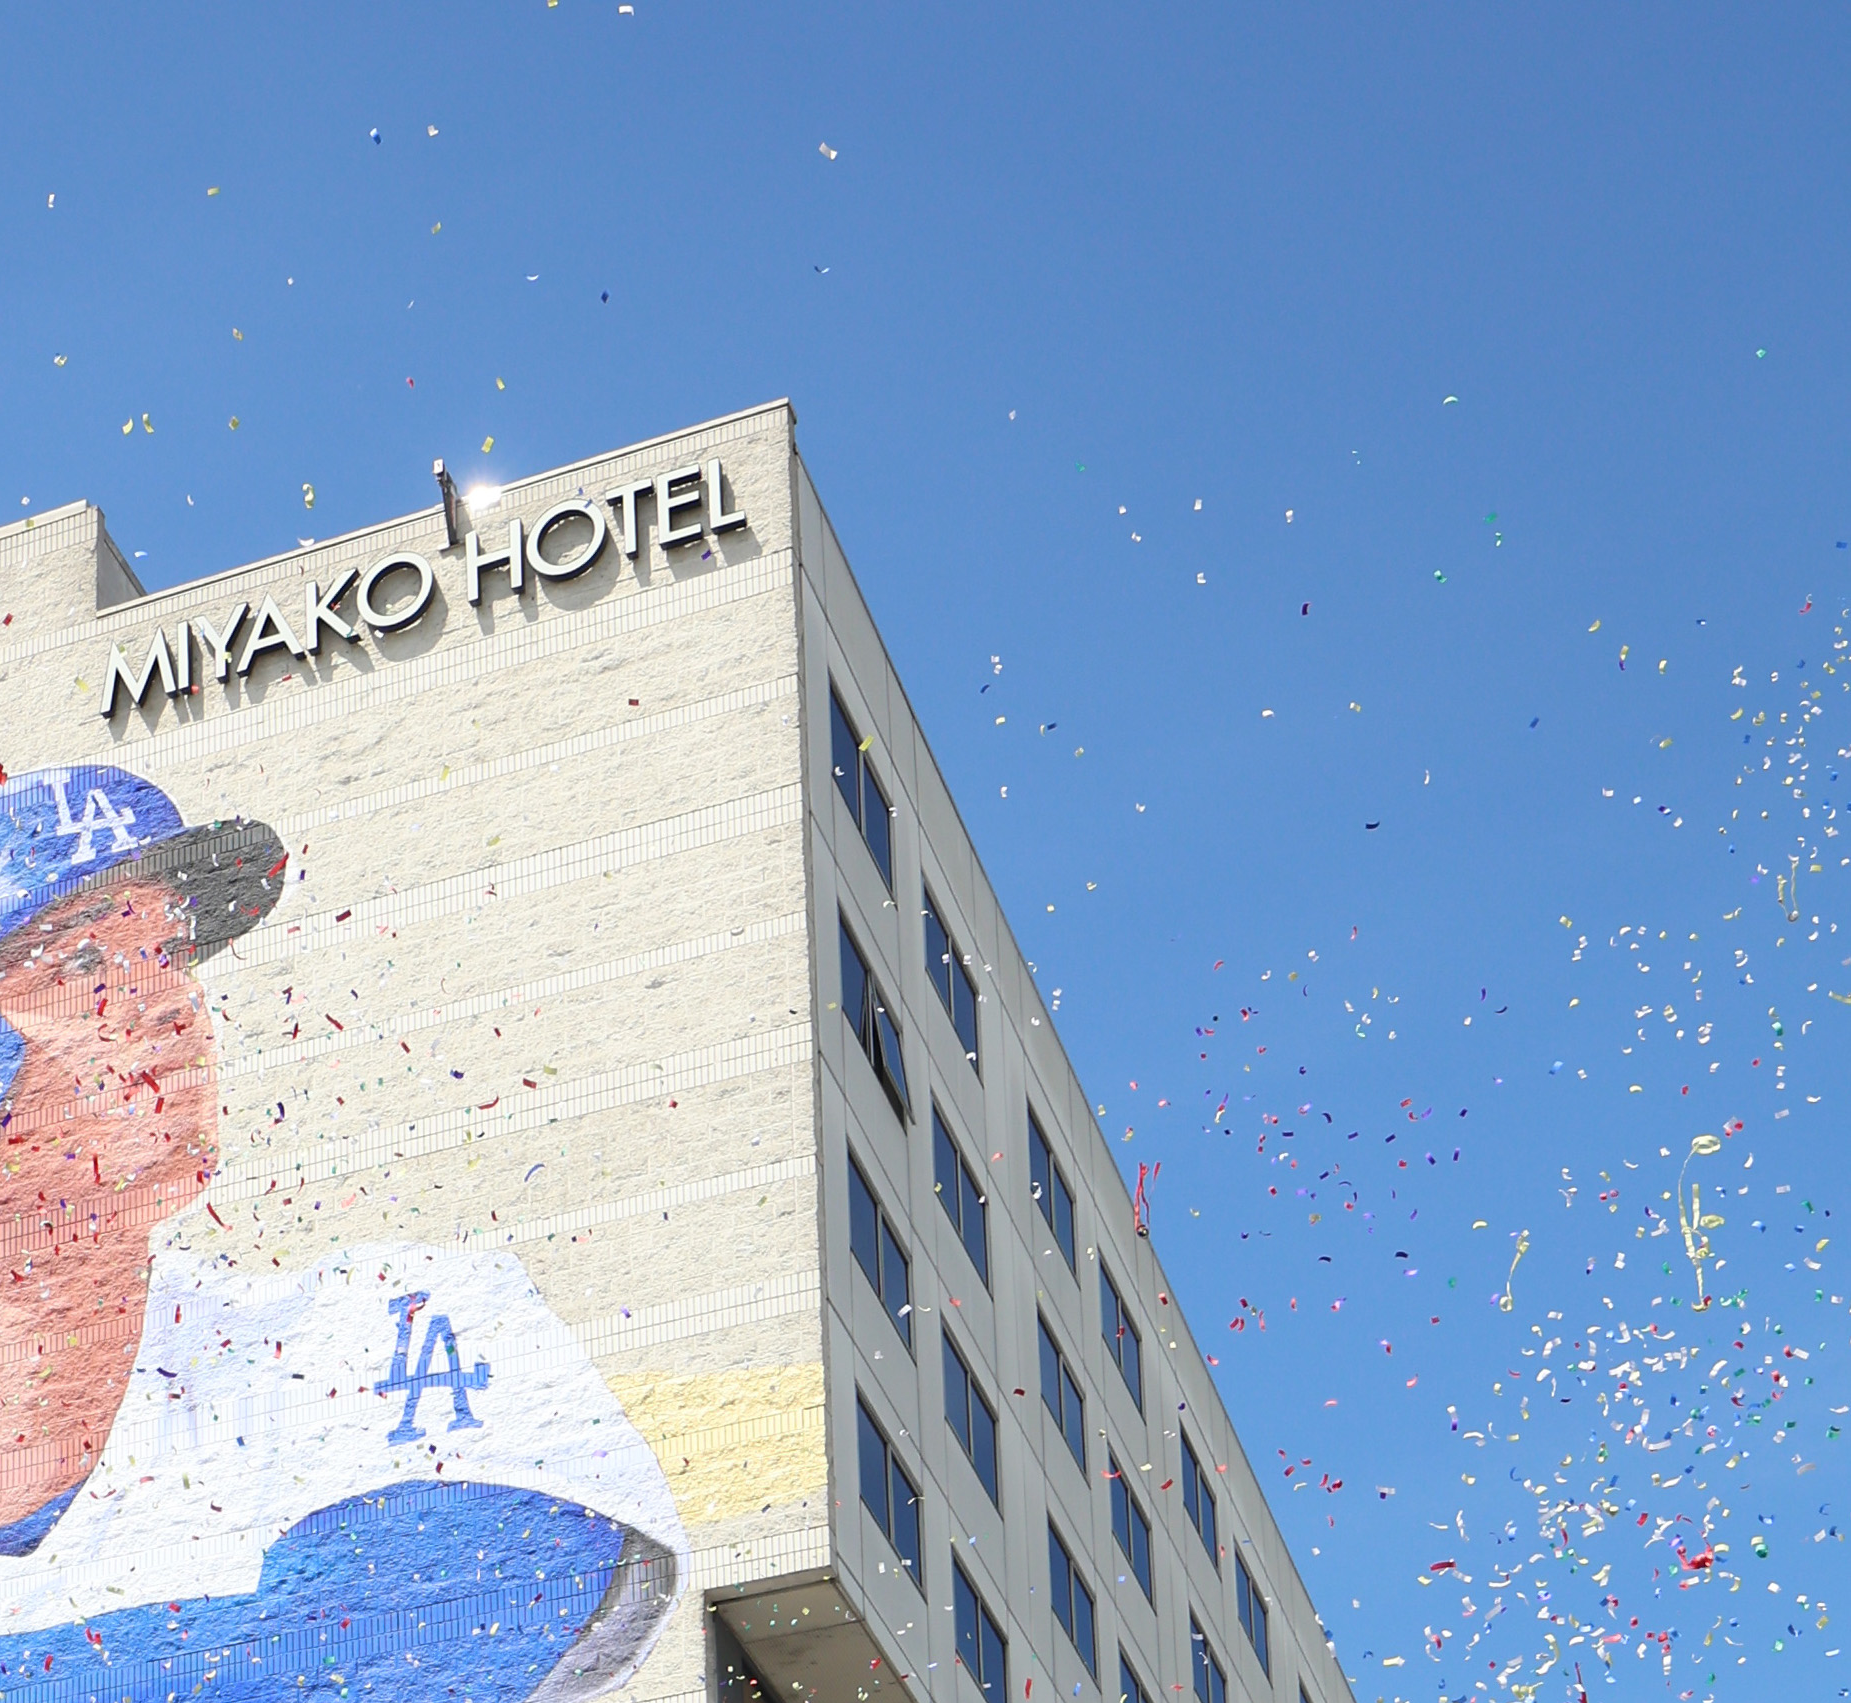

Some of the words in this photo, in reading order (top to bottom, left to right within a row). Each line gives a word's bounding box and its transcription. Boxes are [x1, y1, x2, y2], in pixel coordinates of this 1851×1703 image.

[99, 550, 435, 718] MIYAKO
[465, 457, 747, 606] HOTEL
[42, 769, 142, 865] LA
[373, 1289, 492, 1446] LA
